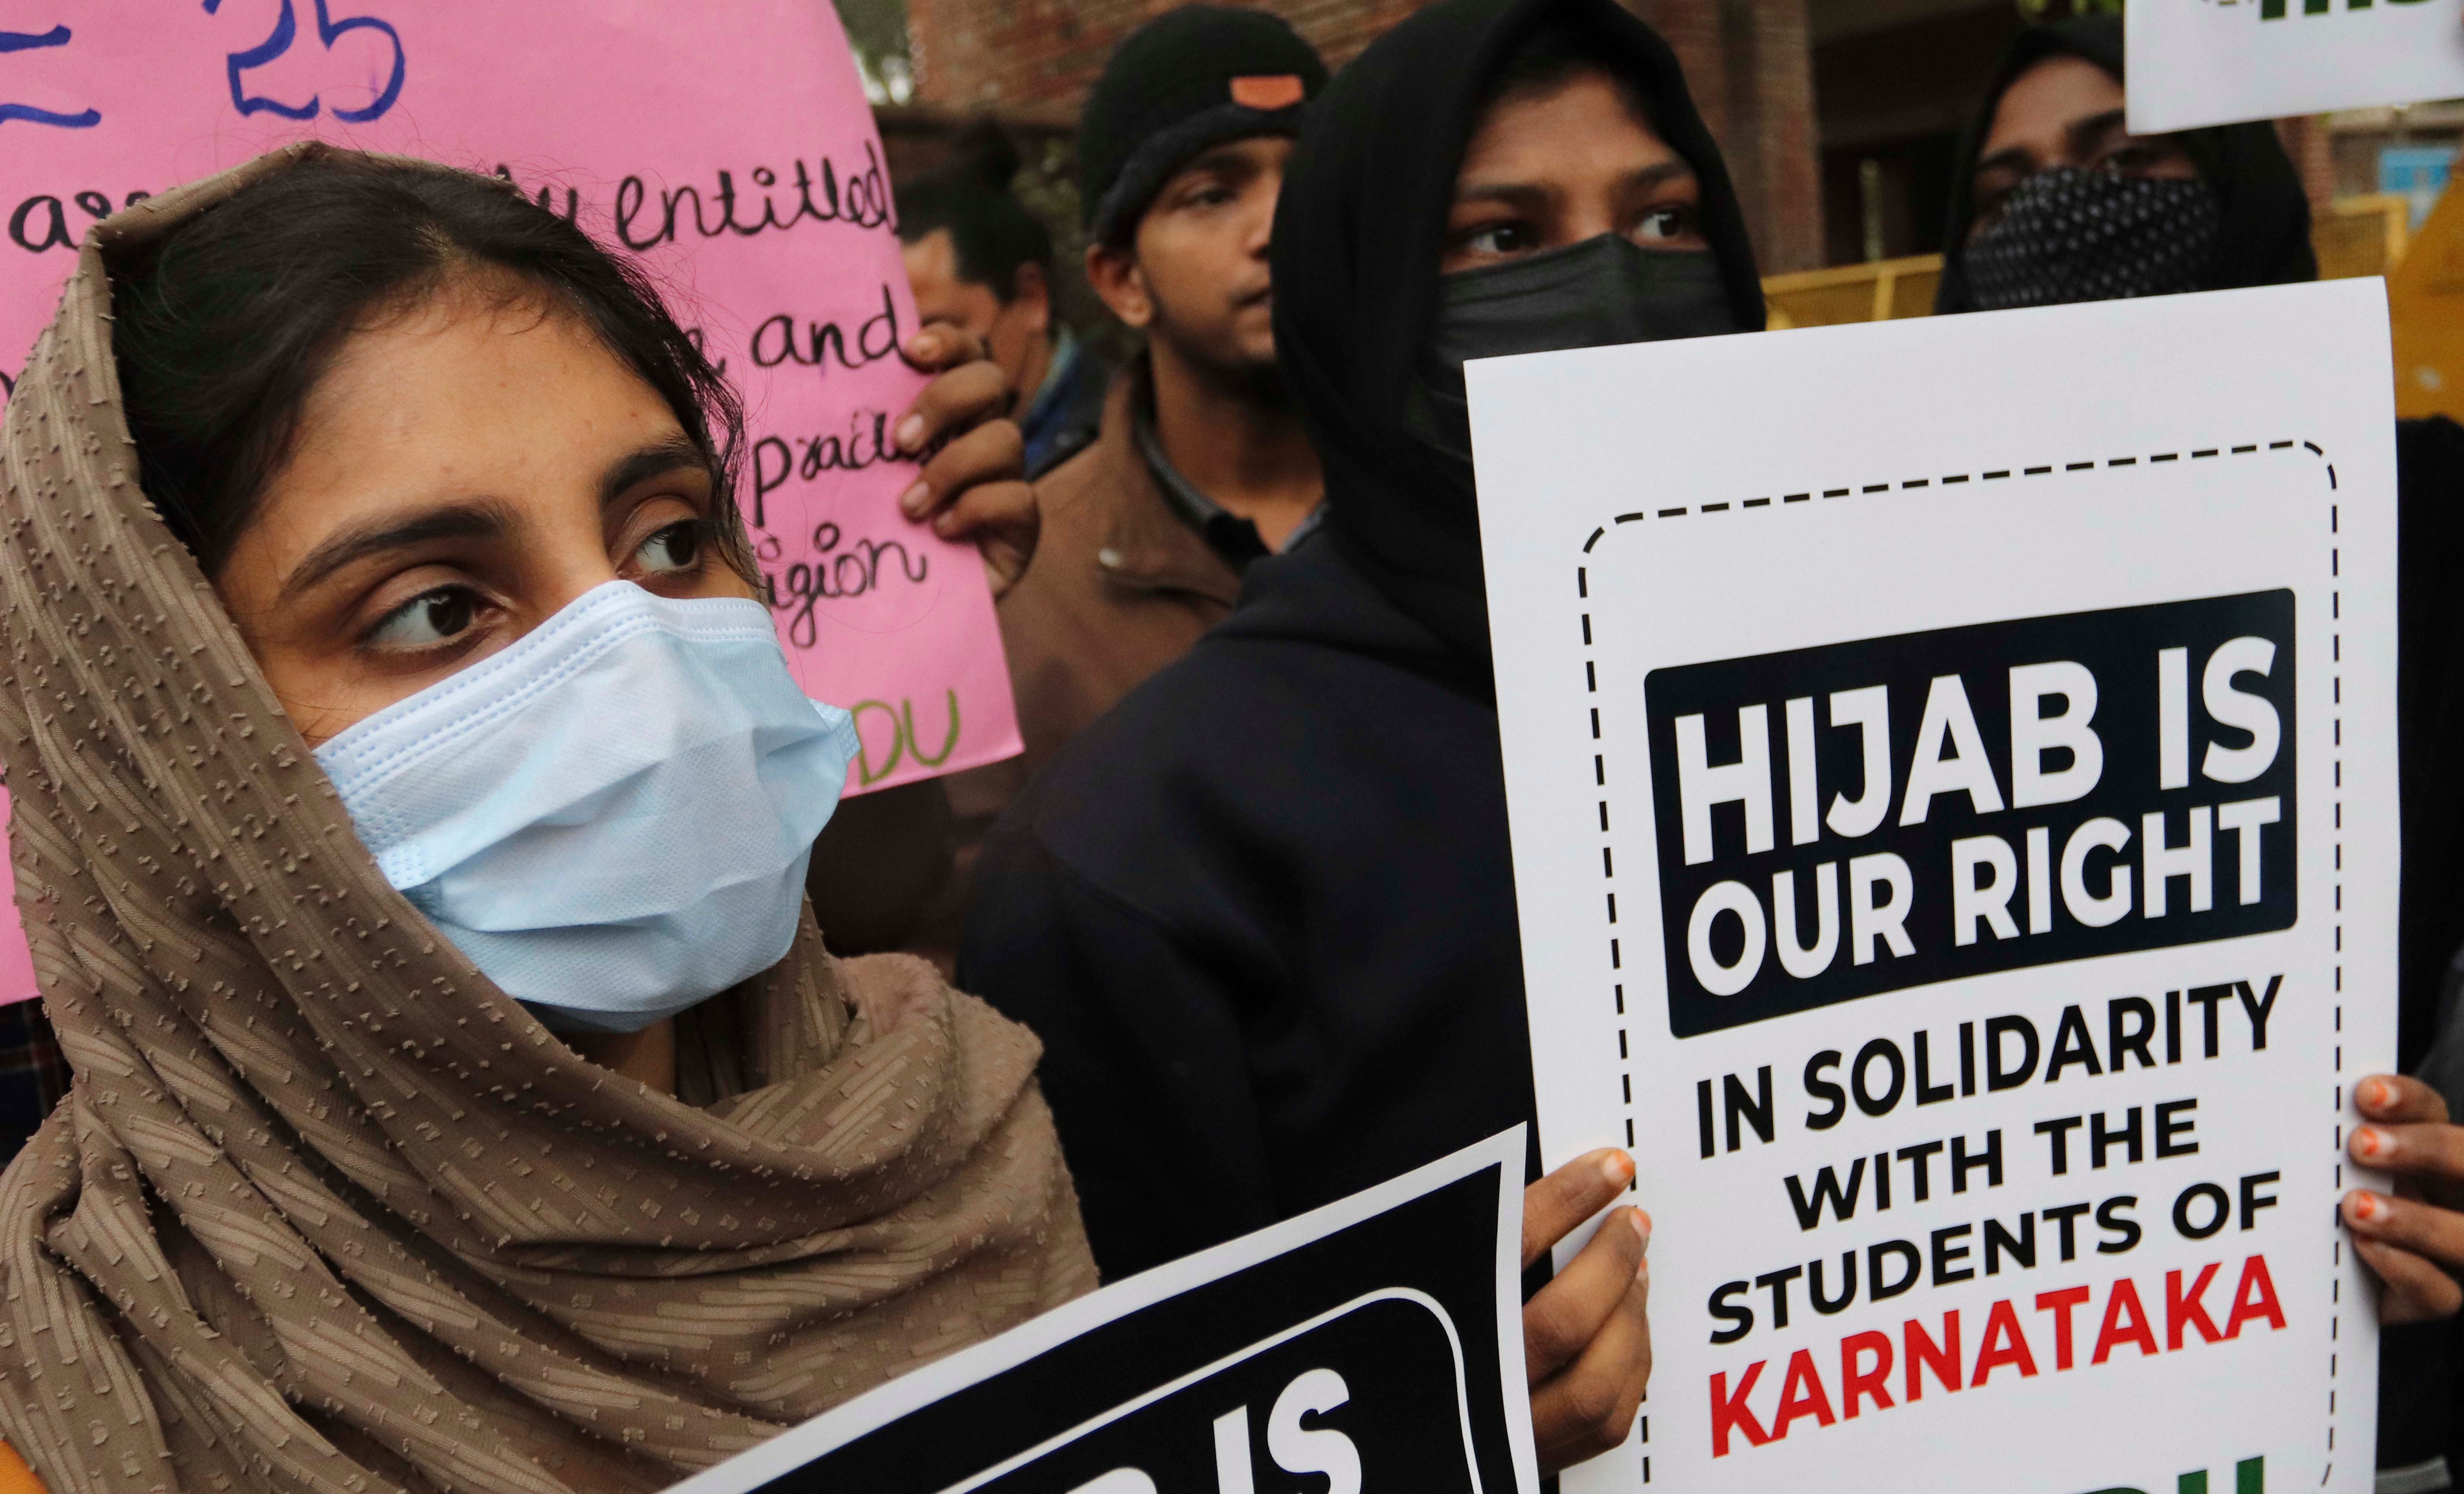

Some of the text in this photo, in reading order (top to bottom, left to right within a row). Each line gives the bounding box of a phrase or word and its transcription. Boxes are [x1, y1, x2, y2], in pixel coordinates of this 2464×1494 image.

[203, 0, 405, 122] 25
[751, 284, 925, 375] and
[757, 521, 927, 649] igion
[1674, 636, 2281, 866] HIJAB IS
[1687, 795, 2281, 996] OUR RIGHT
[1697, 974, 2284, 1159] IN SOLIDARITY
[1783, 1098, 2199, 1231] WITH THE
[1708, 1170, 2280, 1345] STUDENTS OF
[1213, 1368, 1362, 1494] IS
[1710, 1254, 2287, 1459] KARNATAKA
